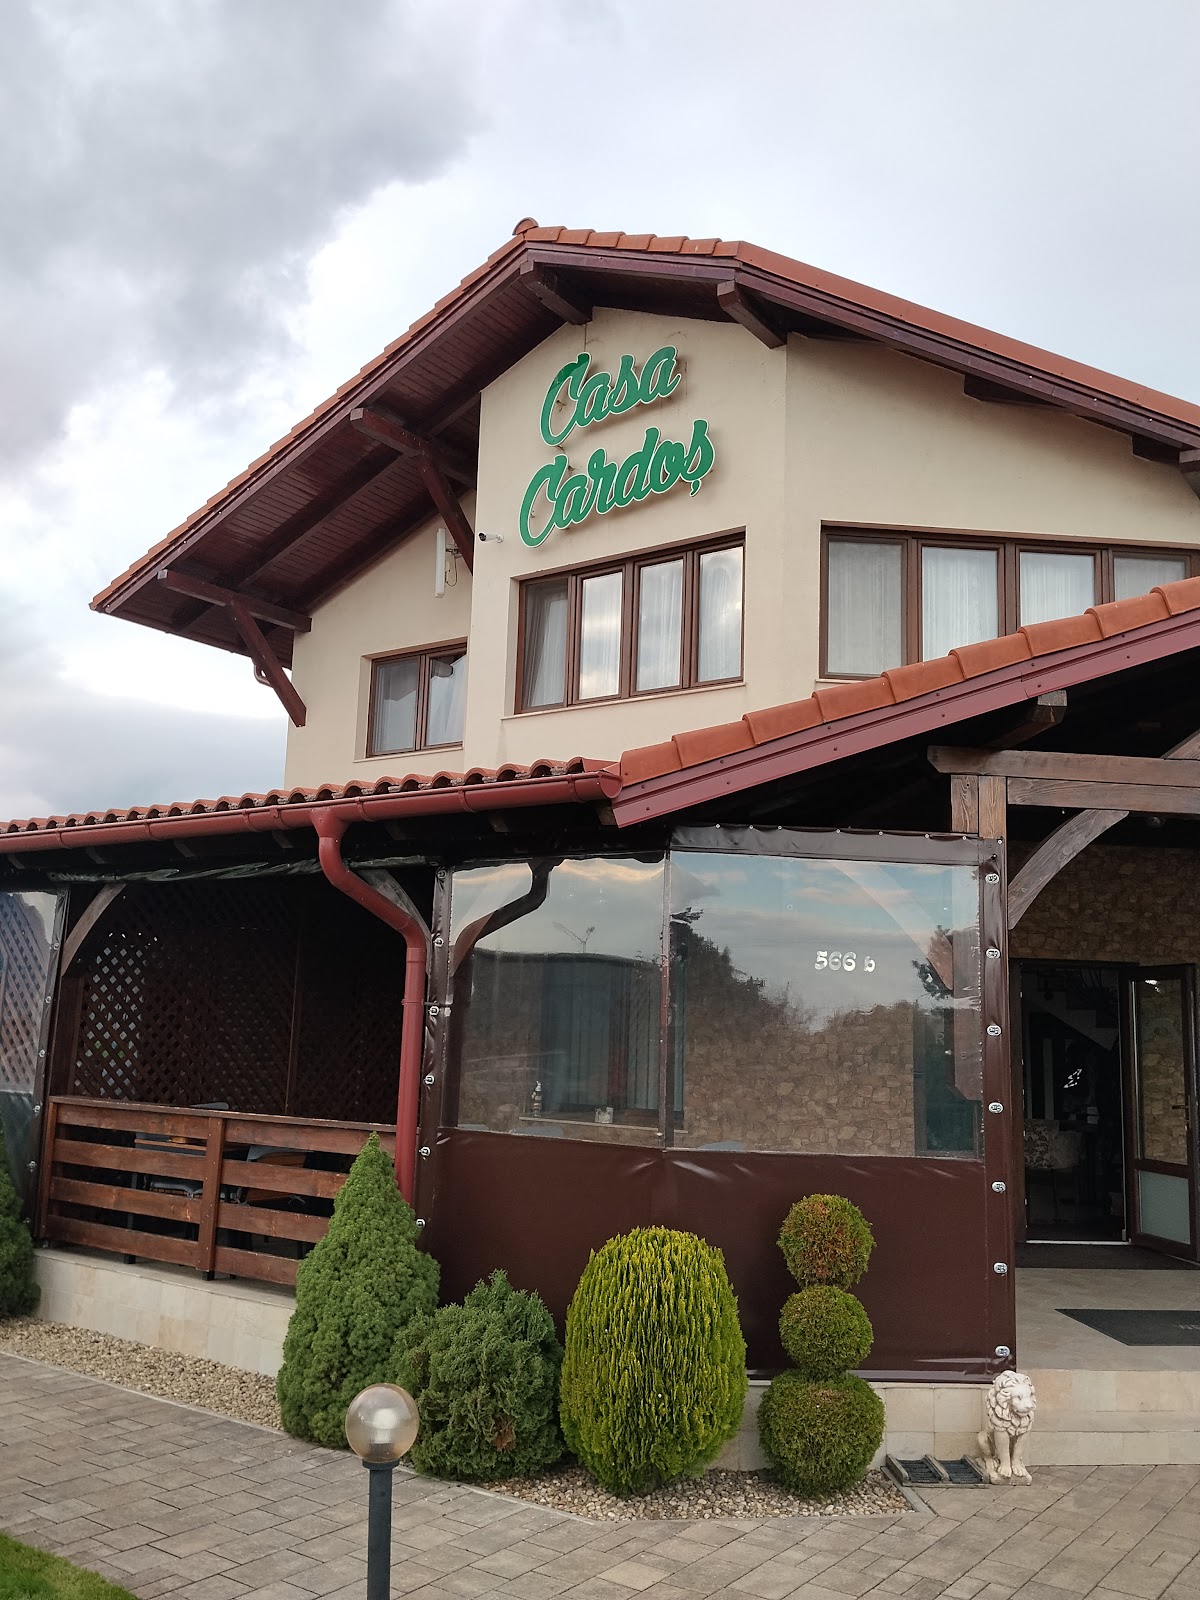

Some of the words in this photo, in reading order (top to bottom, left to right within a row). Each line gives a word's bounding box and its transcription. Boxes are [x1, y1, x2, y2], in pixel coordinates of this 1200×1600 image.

[540, 345, 682, 447] Casa
[518, 418, 715, 547] Cardoș
[814, 950, 857, 972] 566
